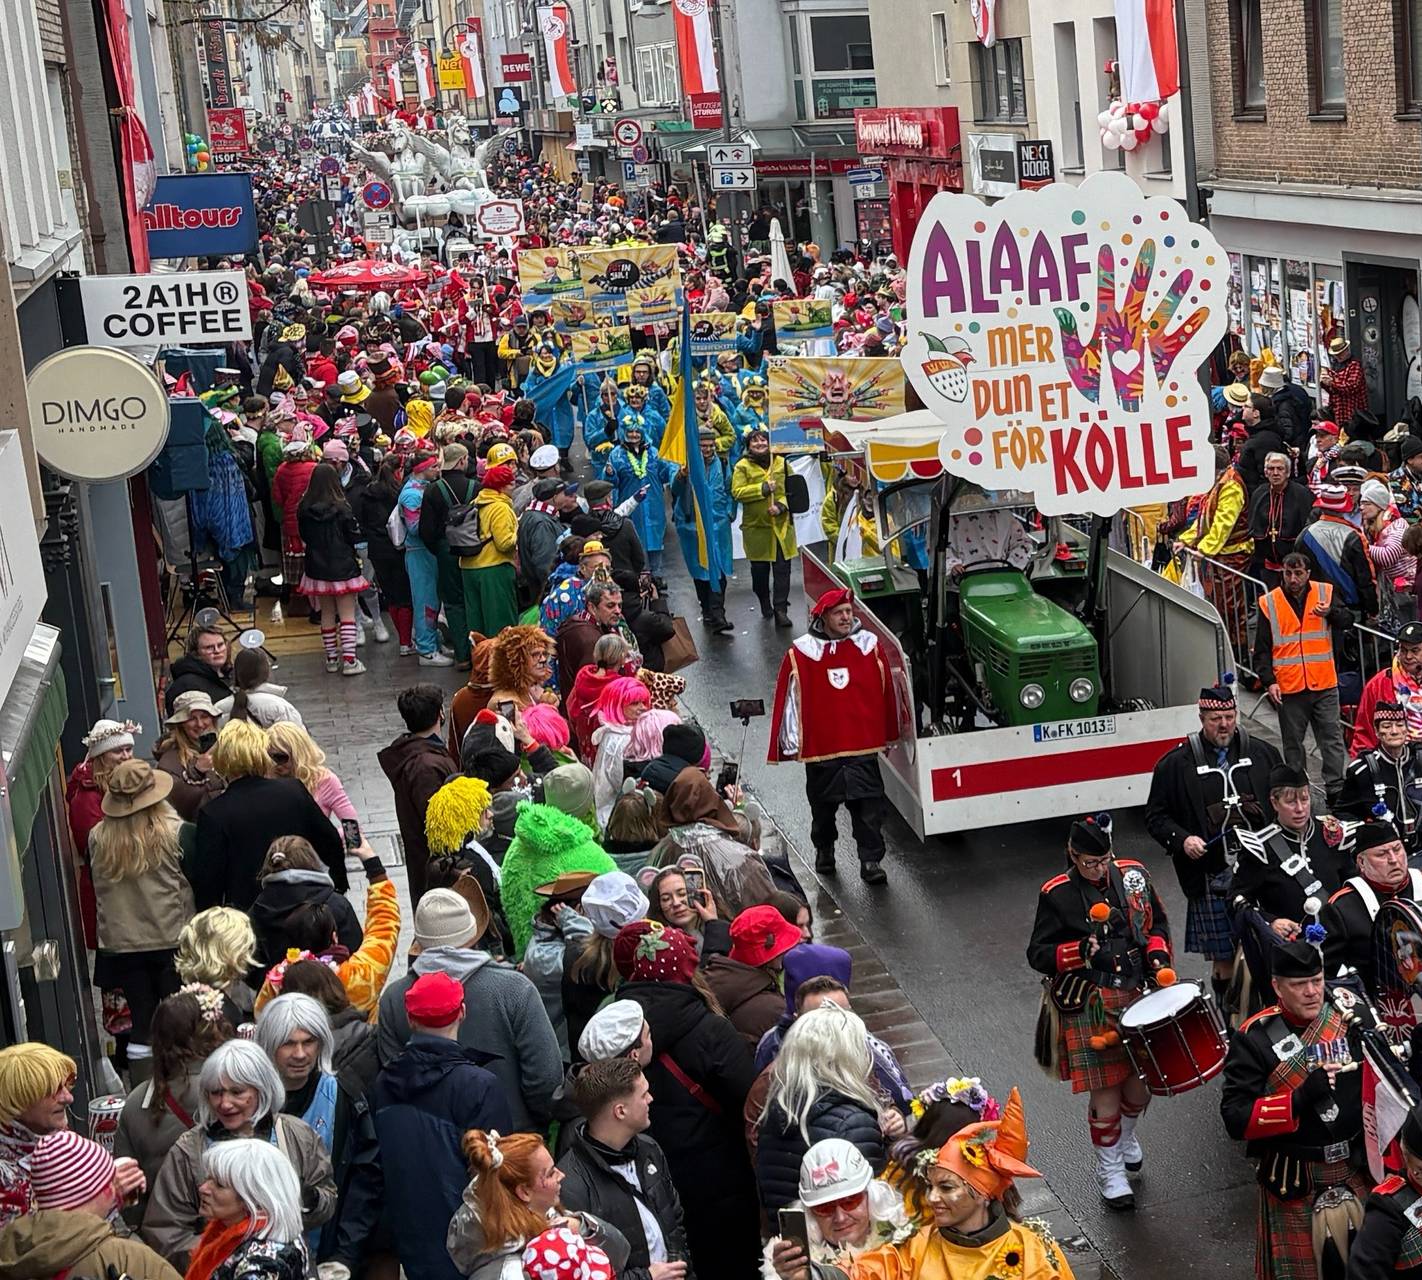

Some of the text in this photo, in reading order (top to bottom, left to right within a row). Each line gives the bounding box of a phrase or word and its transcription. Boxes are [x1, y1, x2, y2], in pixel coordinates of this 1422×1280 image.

[503, 63, 531, 73] REWE
[1021, 145, 1049, 161] NEXT
[1022, 159, 1051, 177] DOOR
[142, 203, 243, 231] alltours
[921, 219, 1092, 318] ALAAF
[103, 309, 243, 339] COFFEE
[42, 396, 146, 425] DIMGO
[1038, 381, 1073, 422] ET
[58, 424, 137, 434] HANDMADE
[991, 410, 1198, 496] FÖR KÖLLE
[1042, 719, 1106, 739] K FK 1013
[952, 768, 963, 787] 1
